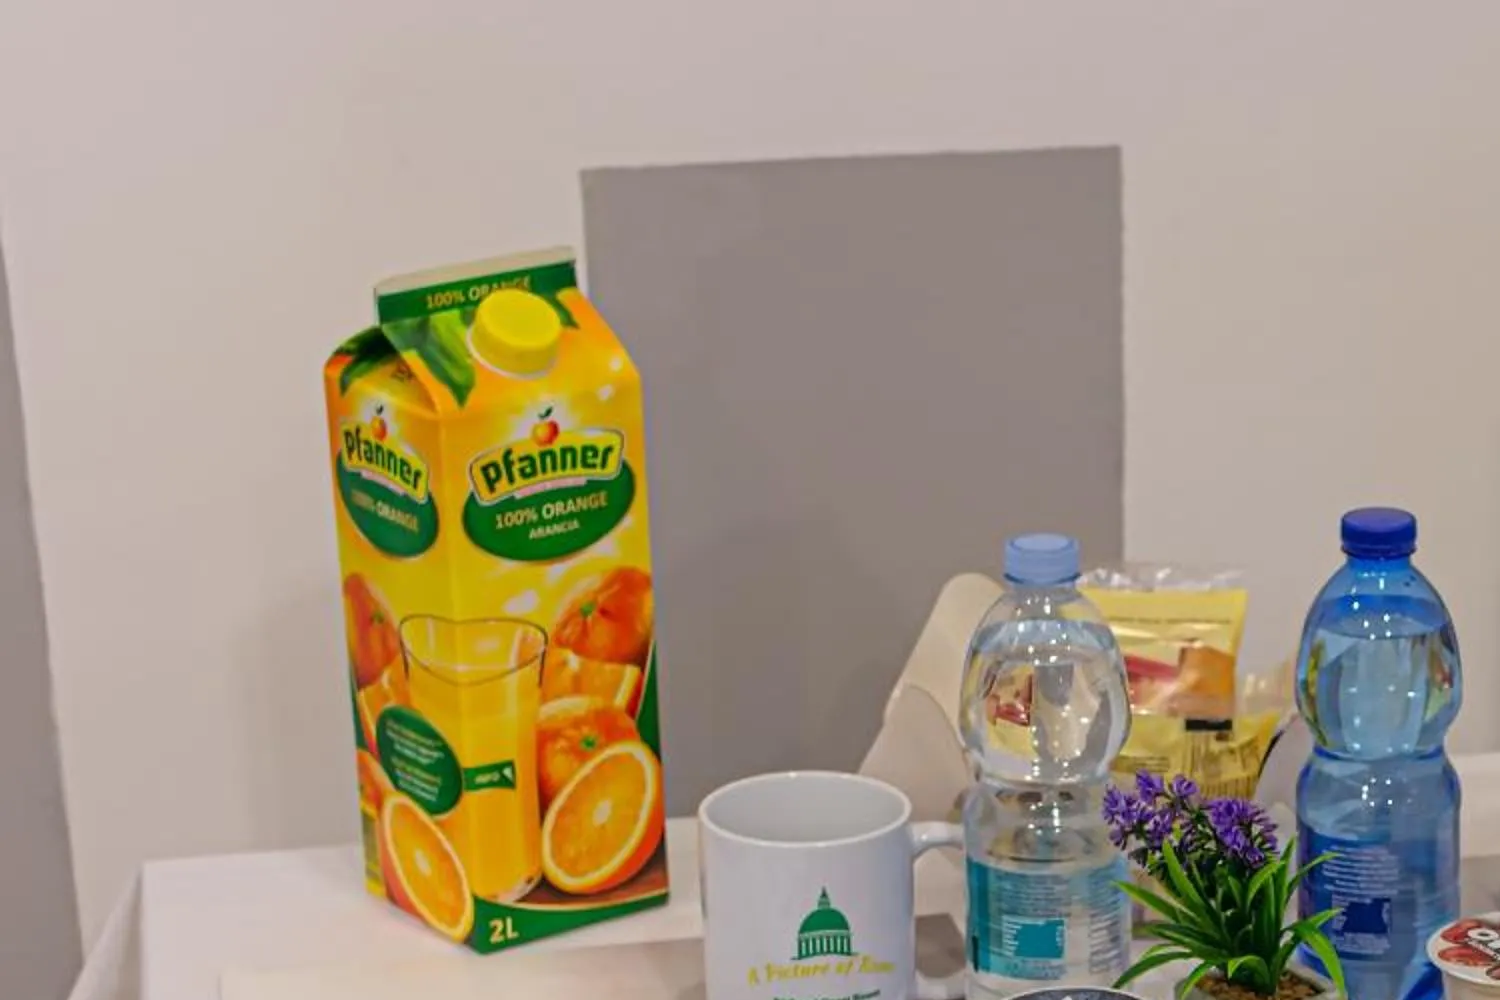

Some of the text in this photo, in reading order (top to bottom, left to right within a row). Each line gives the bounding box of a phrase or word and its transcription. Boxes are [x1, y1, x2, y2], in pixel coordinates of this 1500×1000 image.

[494, 491, 609, 530] 100% ORANGE
[488, 917, 519, 944] 2L
[747, 967, 760, 987] A
